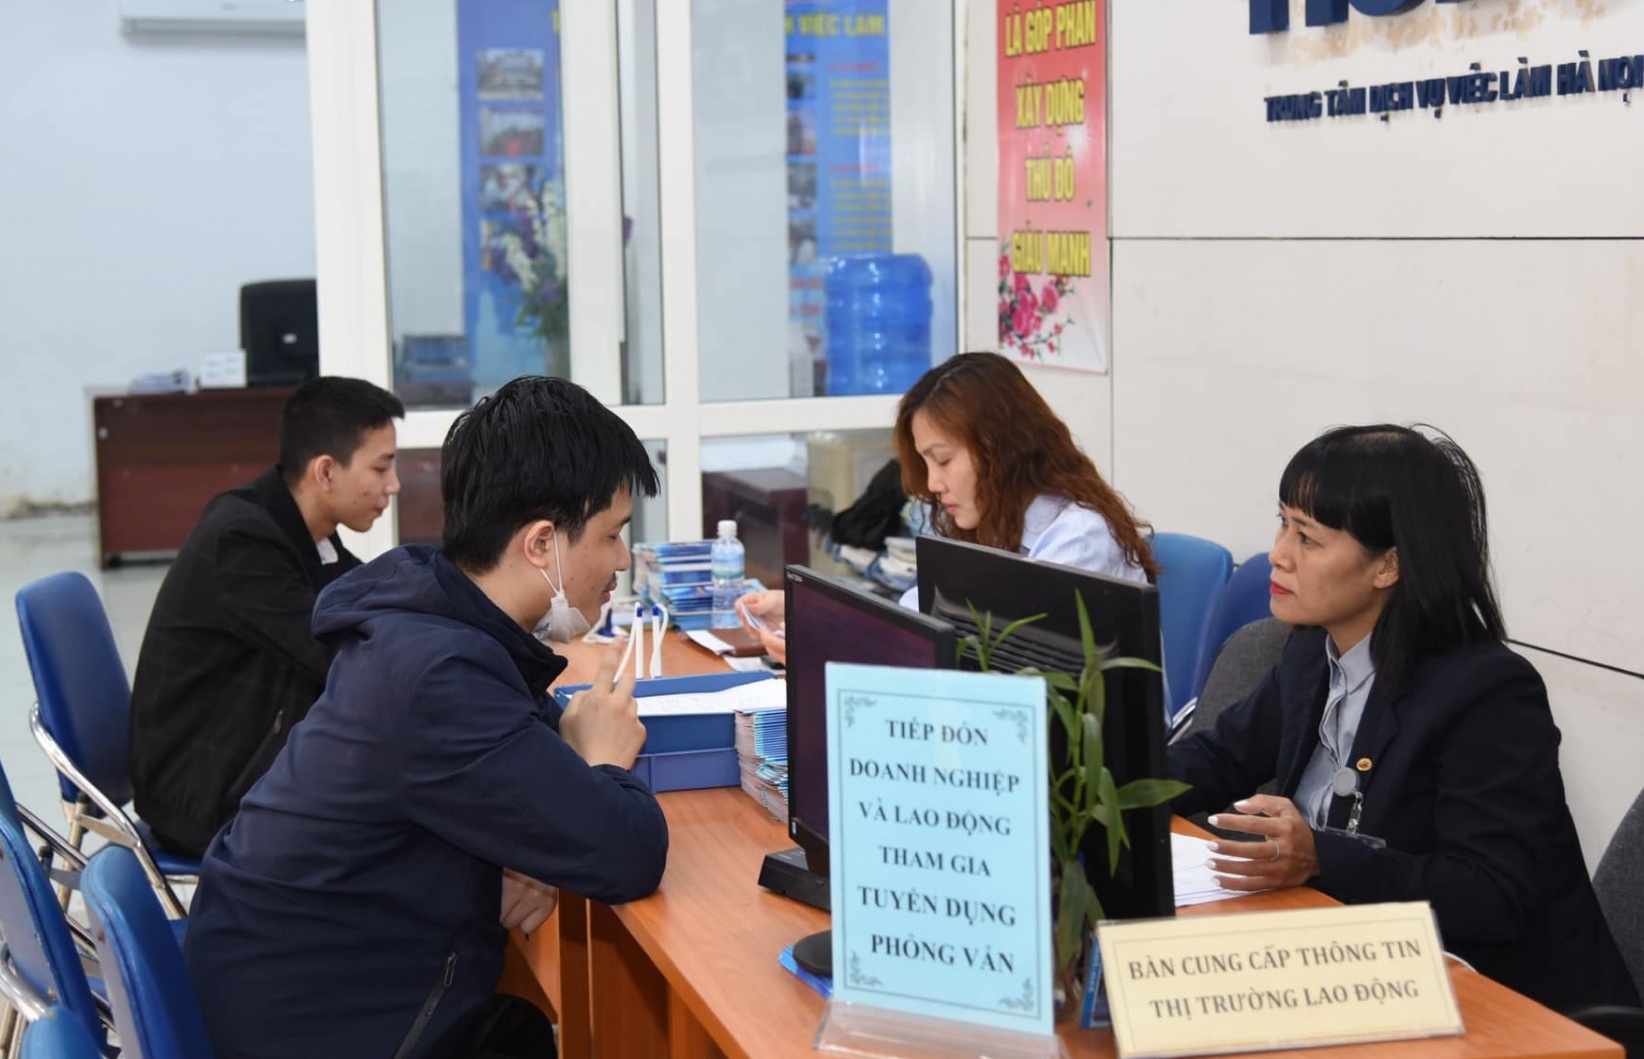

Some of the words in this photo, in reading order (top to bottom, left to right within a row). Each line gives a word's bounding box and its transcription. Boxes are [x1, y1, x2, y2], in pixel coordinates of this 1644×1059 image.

[1016, 74, 1042, 129] XÂY
[1264, 91, 1322, 122] TRUNG
[1324, 80, 1367, 117] TÂM
[1369, 81, 1414, 122] DỊCH
[1415, 78, 1446, 119] VỤ
[1499, 57, 1552, 101] LÀM
[1557, 49, 1596, 96] HÀ
[885, 717, 934, 741] TIẾP
[850, 757, 927, 784] DOANH
[934, 766, 1020, 796] NGHIỆP
[859, 797, 888, 822] VÀ
[894, 804, 940, 827] LAO
[946, 809, 1011, 837] ĐỘNG
[878, 844, 944, 871] THAM
[950, 854, 991, 877] GIA
[946, 897, 1016, 927] DỤNG
[1128, 954, 1176, 980] BÀN
[1181, 952, 1243, 976] CUNG
[1248, 943, 1291, 971] CẤP
[1296, 940, 1377, 967] THÔNG
[1381, 938, 1422, 960] TIN
[1149, 996, 1192, 1021] THỊ
[1195, 986, 1299, 1016] TRƯỜNG
[1303, 984, 1349, 1007] LAO
[1353, 976, 1419, 1006] ĐỘNG
